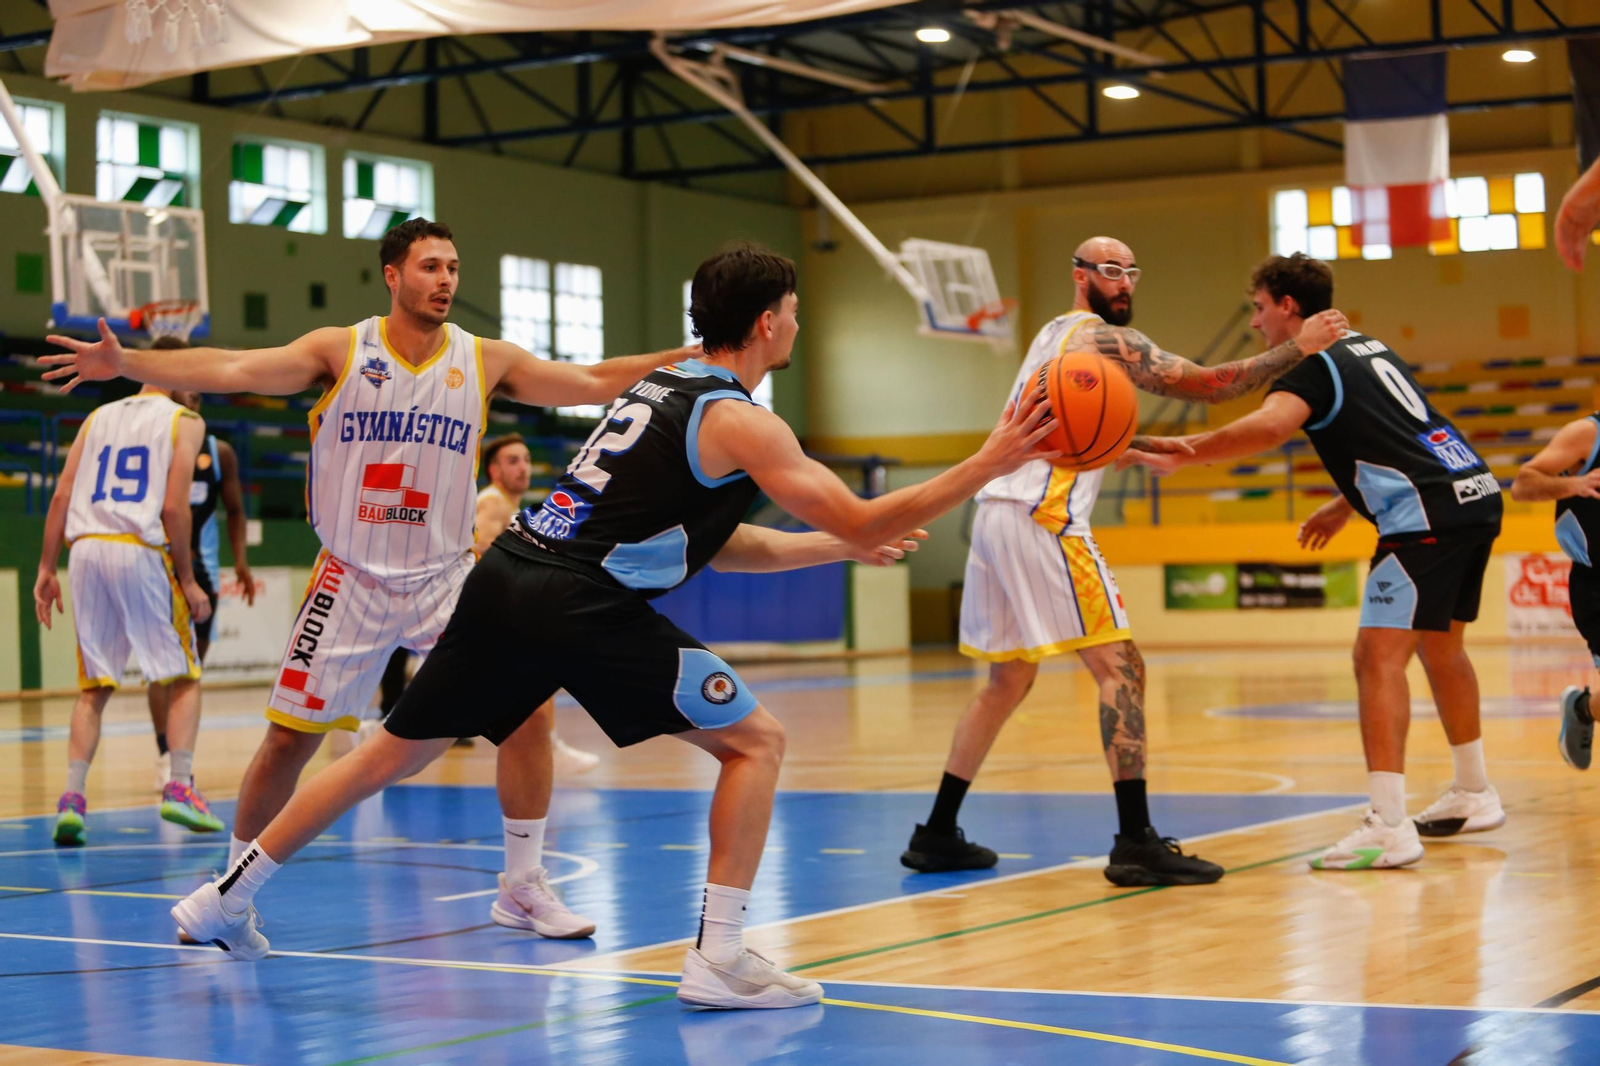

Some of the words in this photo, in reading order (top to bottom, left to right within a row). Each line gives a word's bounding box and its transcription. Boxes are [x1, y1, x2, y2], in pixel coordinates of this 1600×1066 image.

[1370, 356, 1430, 423] 0
[340, 405, 472, 455] GYMNÁSTICA
[91, 444, 150, 504] 19
[358, 504, 428, 523] BAUBLOCK
[290, 556, 346, 668] AUBLOCK
